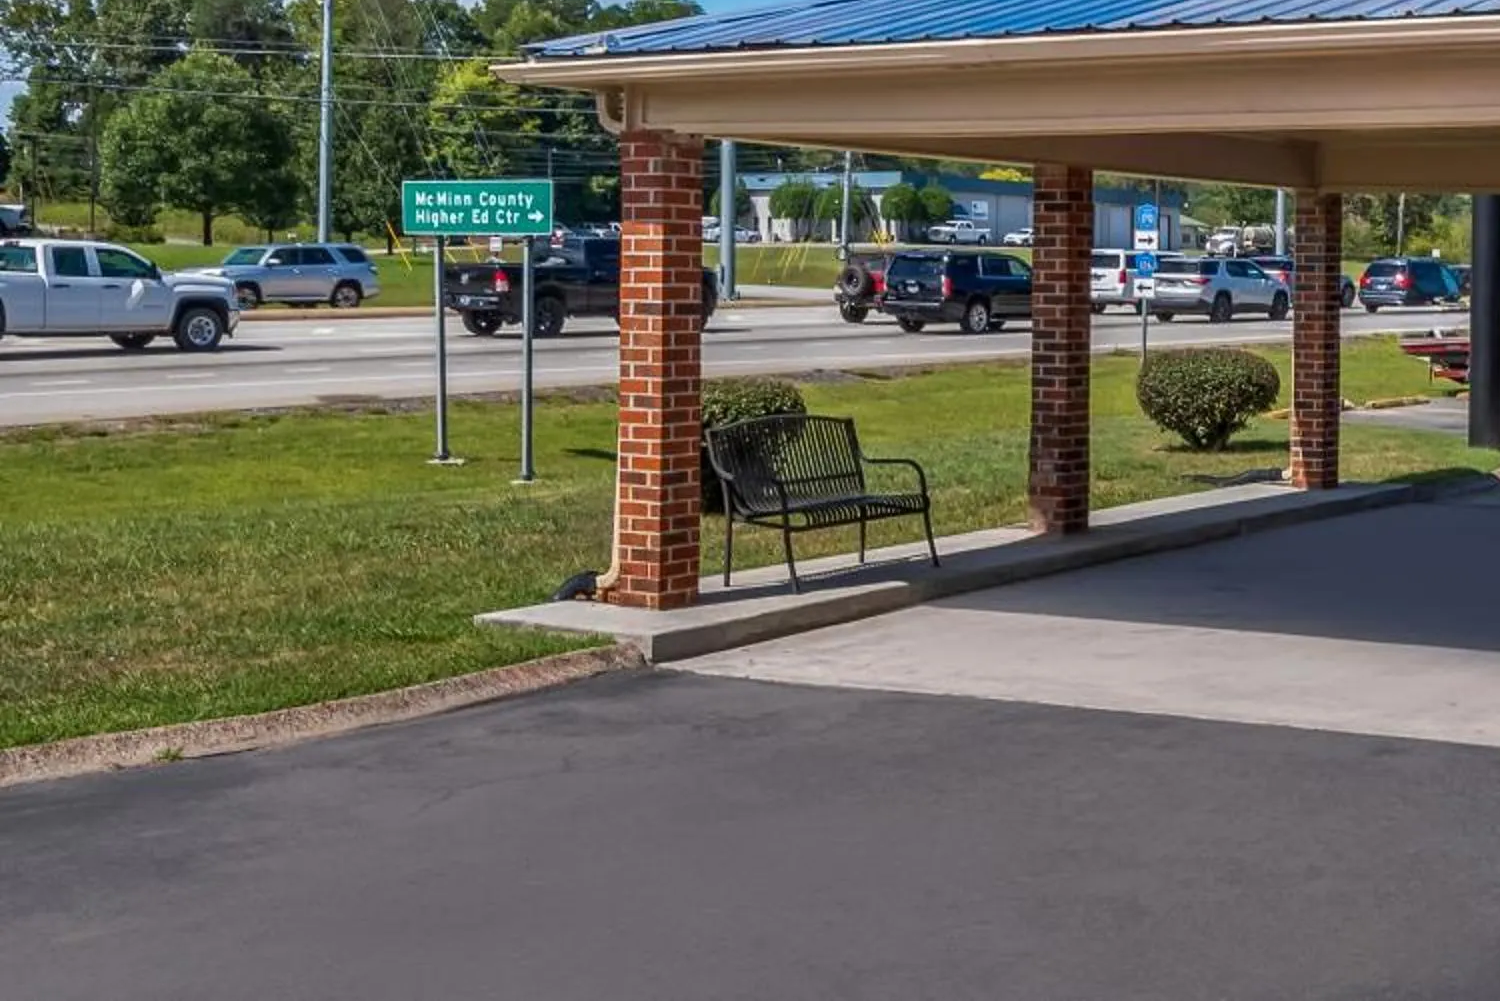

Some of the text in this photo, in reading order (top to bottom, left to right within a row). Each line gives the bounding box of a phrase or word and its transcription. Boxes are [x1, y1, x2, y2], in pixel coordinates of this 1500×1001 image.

[415, 191, 534, 209] McMinn County
[415, 209, 520, 227] Higher Ed Ctr
